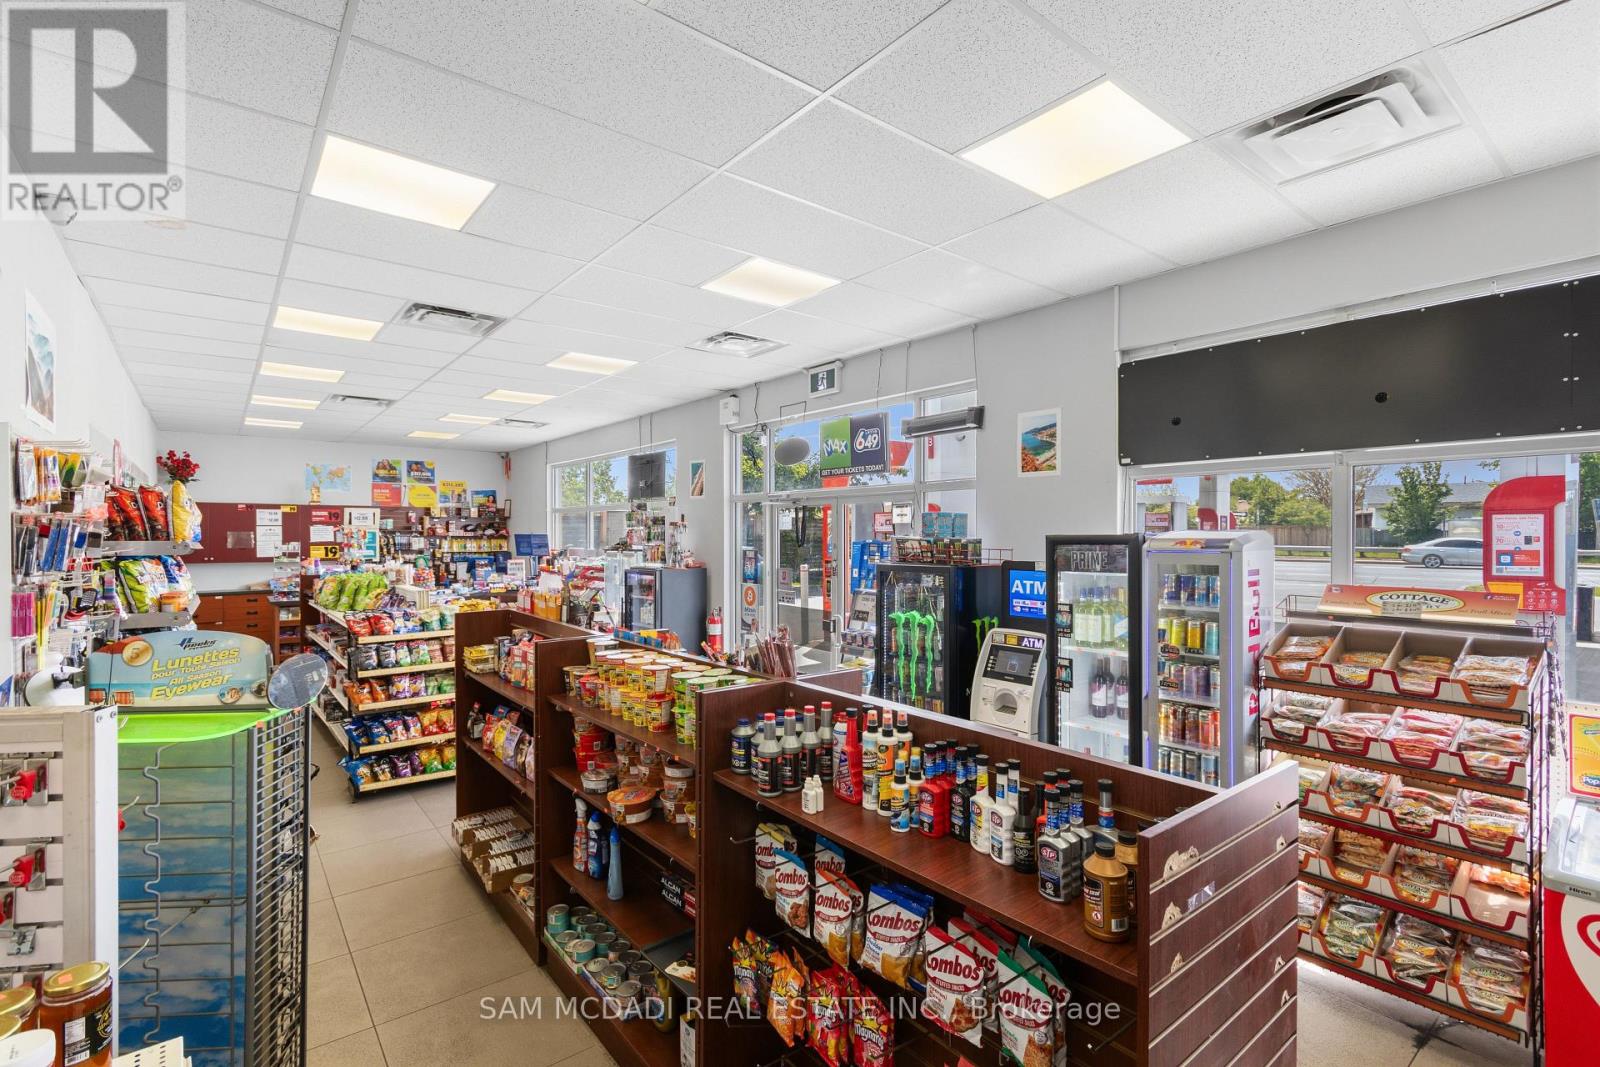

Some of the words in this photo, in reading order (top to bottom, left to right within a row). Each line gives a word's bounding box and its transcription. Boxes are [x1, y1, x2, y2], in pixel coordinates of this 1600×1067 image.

[823, 439, 848, 457] MAX
[832, 467, 845, 475] YOUR
[845, 466, 865, 474] TICKETS
[865, 464, 884, 472] TODAY!
[328, 512, 340, 521] 19
[324, 546, 339, 558] 19
[1071, 550, 1109, 570] PRIME
[1011, 579, 1046, 595] ATM
[1378, 593, 1453, 605] COTTAGE
[1021, 638, 1043, 649] ATM
[151, 647, 240, 672] Lunettes
[151, 674, 231, 700] Eyewear
[1041, 848, 1057, 859] STP
[774, 867, 807, 886] Combos
[660, 877, 681, 895] ALCAN
[661, 889, 682, 907] ALCAN
[854, 1024, 884, 1050] Maynards
